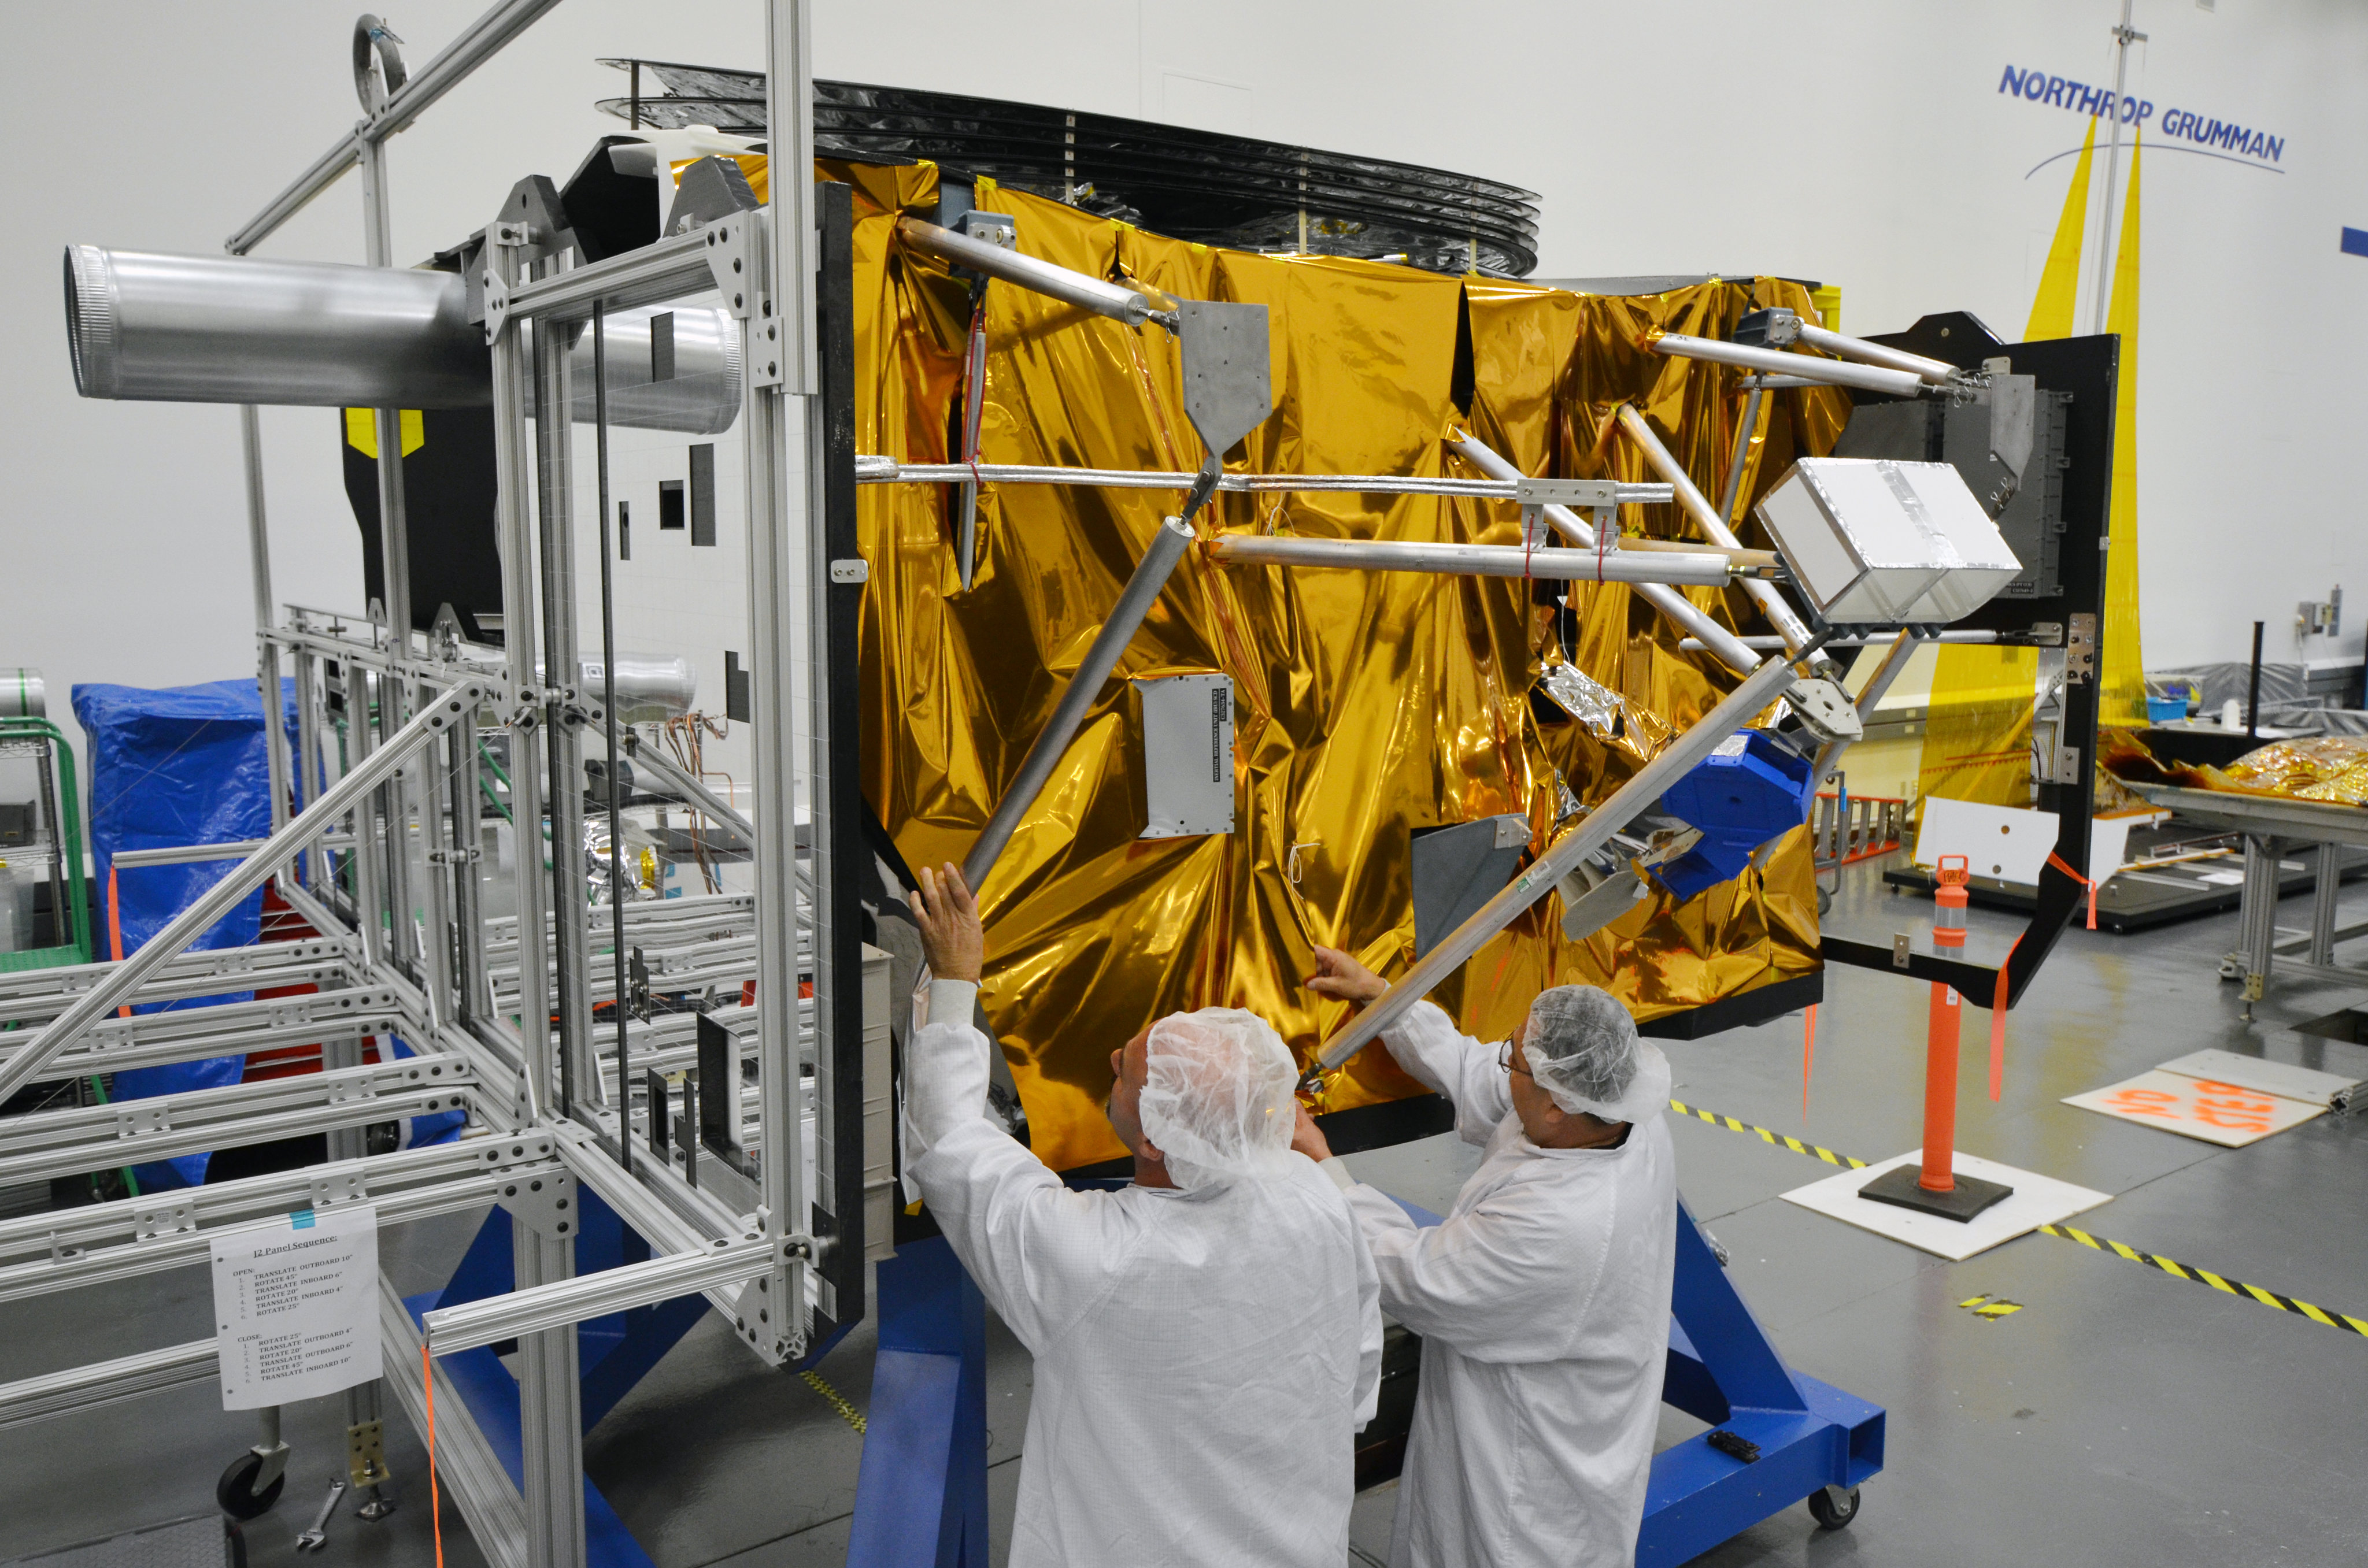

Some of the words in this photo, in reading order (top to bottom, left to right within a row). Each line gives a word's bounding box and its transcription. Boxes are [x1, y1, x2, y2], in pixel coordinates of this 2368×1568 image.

[1998, 65, 2153, 127] NORTHROP
[2162, 109, 2285, 162] GRUMMAN
[2101, 1090, 2182, 1119] NO
[2192, 1080, 2276, 1133] STEP
[254, 1250, 263, 1258] J2
[265, 1244, 290, 1255] Panel
[293, 1235, 337, 1250] Sequence:
[233, 1268, 254, 1277] OPEN:
[254, 1266, 297, 1280] TRANSLATE
[300, 1258, 339, 1270] OUTBOARD
[255, 1277, 284, 1287] ROTATE
[256, 1281, 297, 1294] TRANSLATE
[301, 1273, 334, 1285] INBOARD
[256, 1292, 284, 1302] ROTATE
[257, 1296, 298, 1308] TRANSLATE
[302, 1288, 334, 1299] INBOARD
[257, 1306, 286, 1316] ROTATE
[238, 1334, 262, 1342] CLOSE:
[259, 1336, 288, 1345] ROTATE
[260, 1340, 301, 1353] TRANSLATE
[305, 1330, 344, 1343] OUTBOARD
[260, 1351, 289, 1360] ROTATE
[261, 1354, 302, 1367] TRANSLATE
[306, 1345, 345, 1358] OUTBOARD
[261, 1365, 290, 1374] ROTATE
[261, 1369, 303, 1381] TRANSLATE
[306, 1361, 338, 1372] INBOARD
